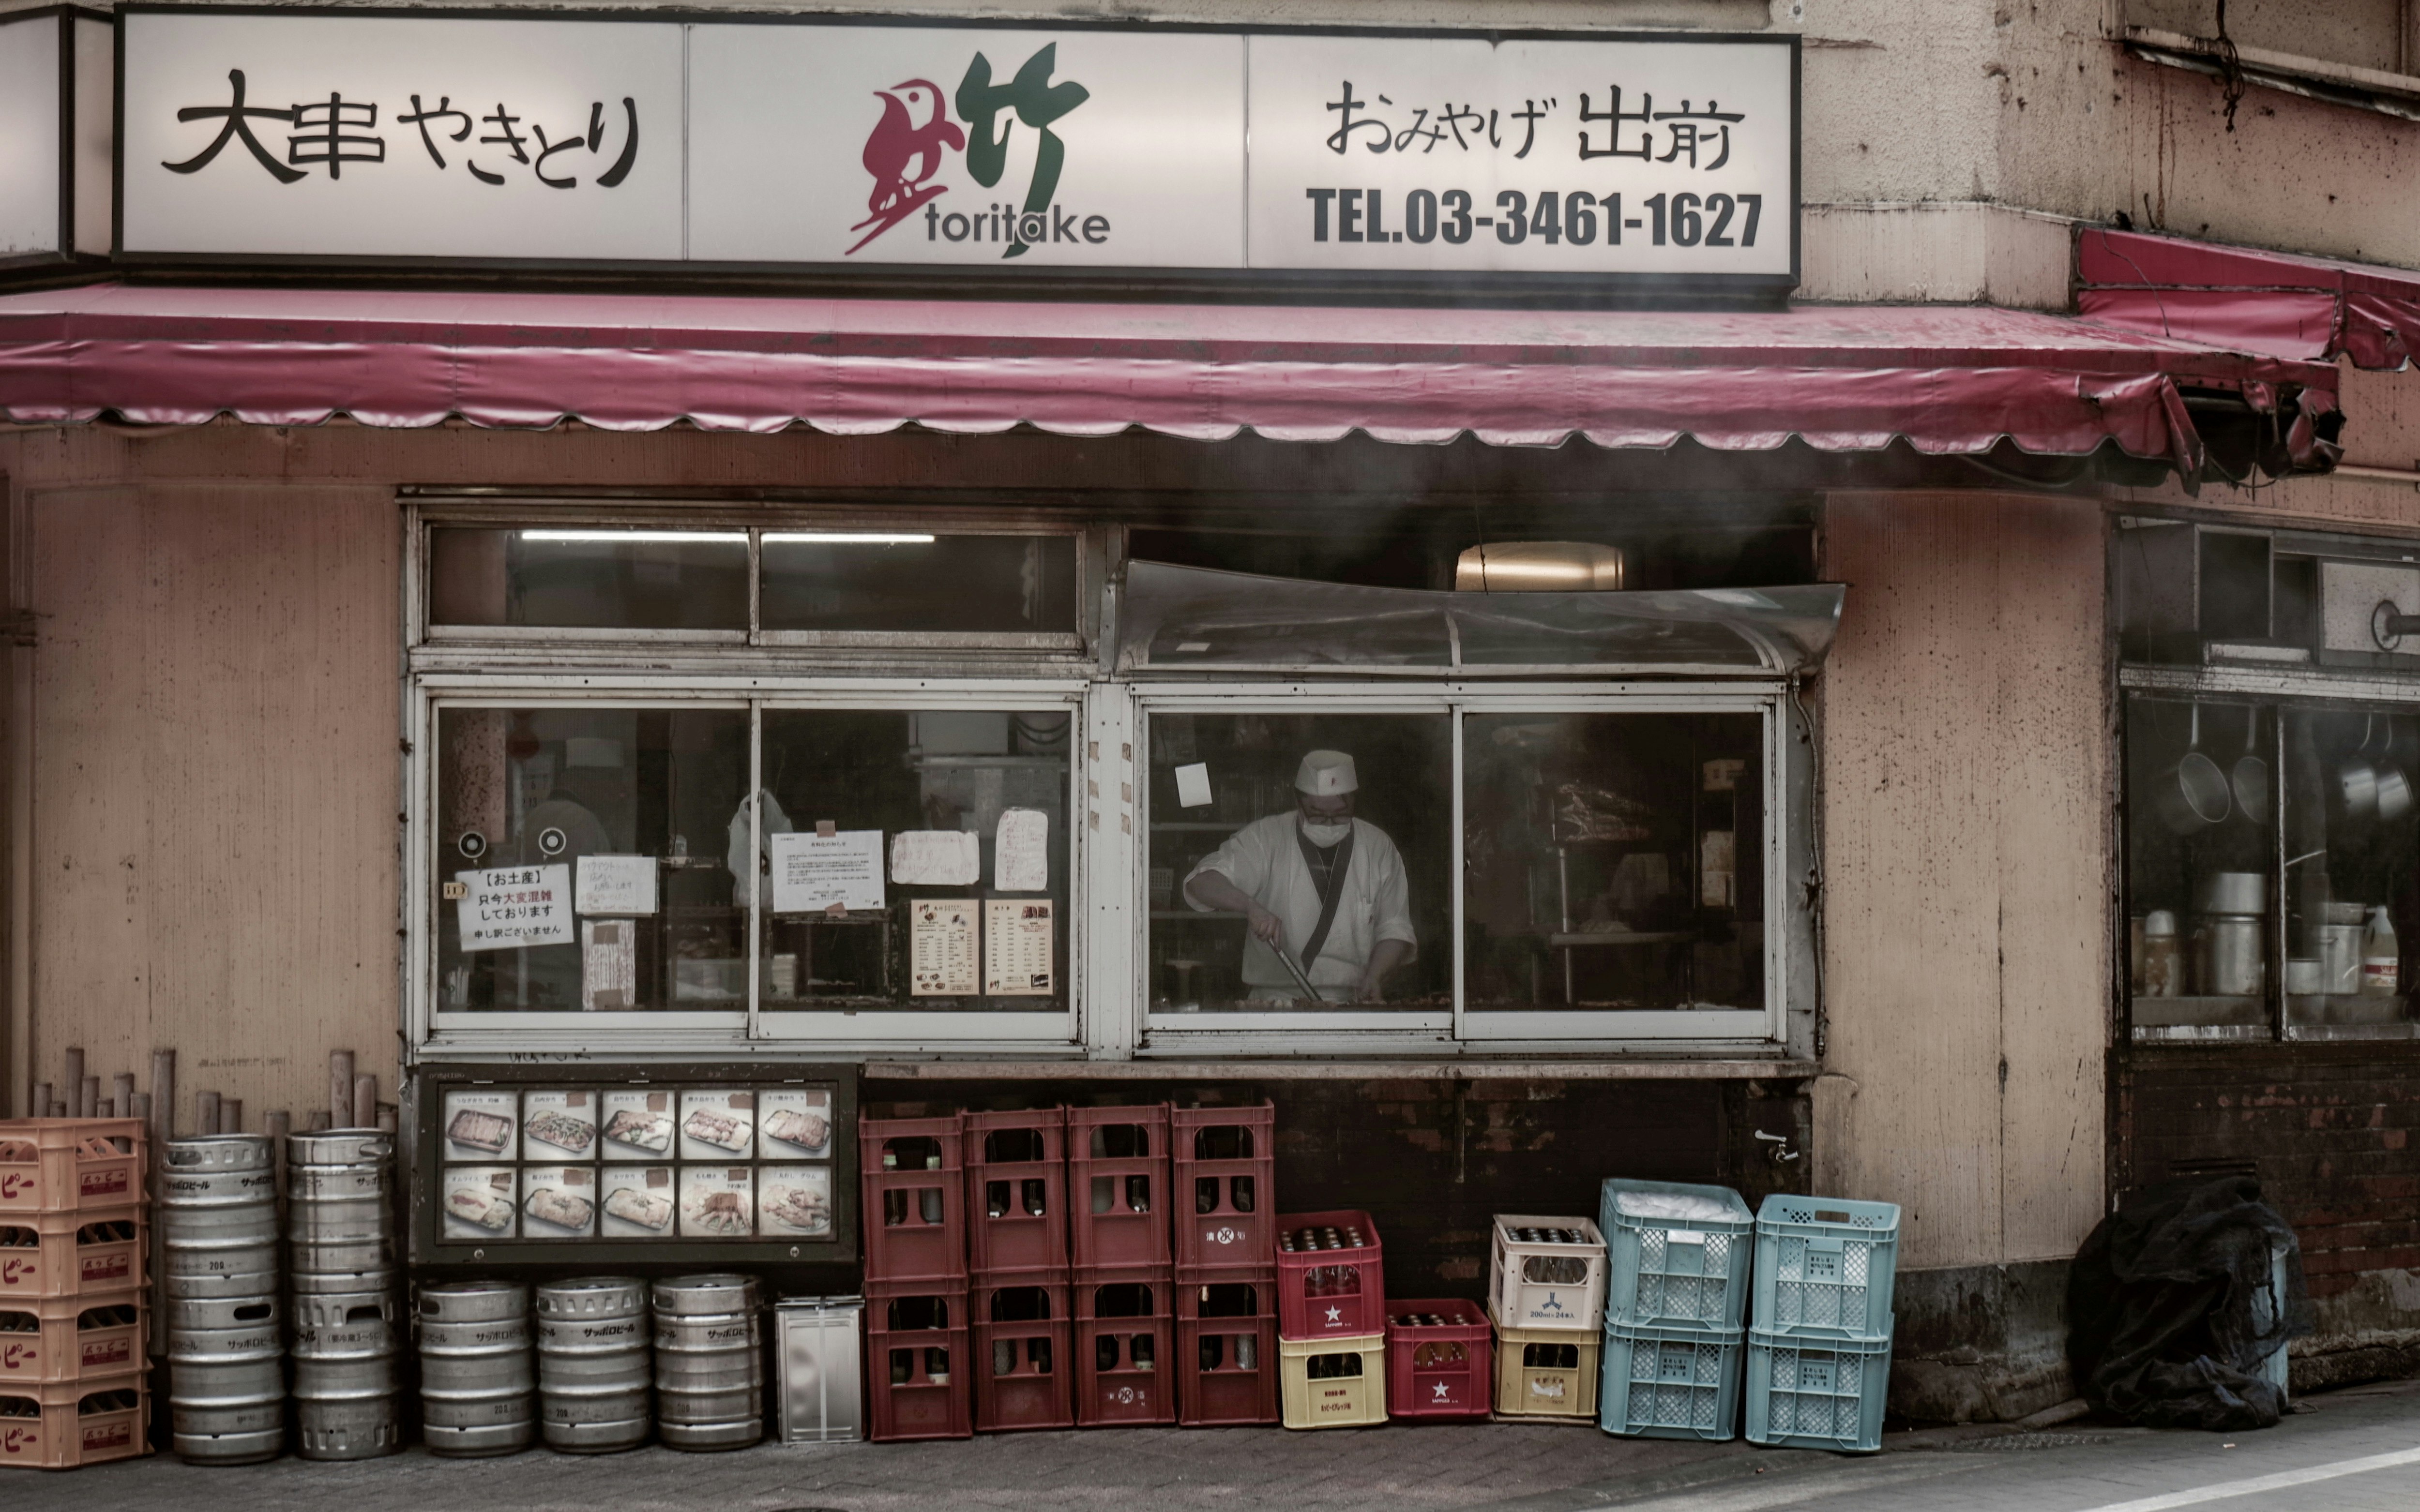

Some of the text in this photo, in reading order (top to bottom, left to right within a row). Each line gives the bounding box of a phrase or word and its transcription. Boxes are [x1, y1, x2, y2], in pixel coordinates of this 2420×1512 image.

[1327, 81, 1746, 170] おみやげ 出前
[925, 203, 1110, 244] toritake
[1306, 188, 1762, 247] TEL.03-3461-1627
[487, 870, 541, 887] 【お土産】
[479, 890, 553, 907] 只今大変混雑
[481, 904, 553, 921] しております
[474, 925, 561, 940] 申し訳ございません
[84, 1172, 124, 1185] ホッピー
[84, 1257, 126, 1270] ホッピー
[583, 1323, 635, 1338] サッポロビール
[85, 1341, 127, 1355] ホッピー
[86, 1426, 128, 1440] ホッピー
